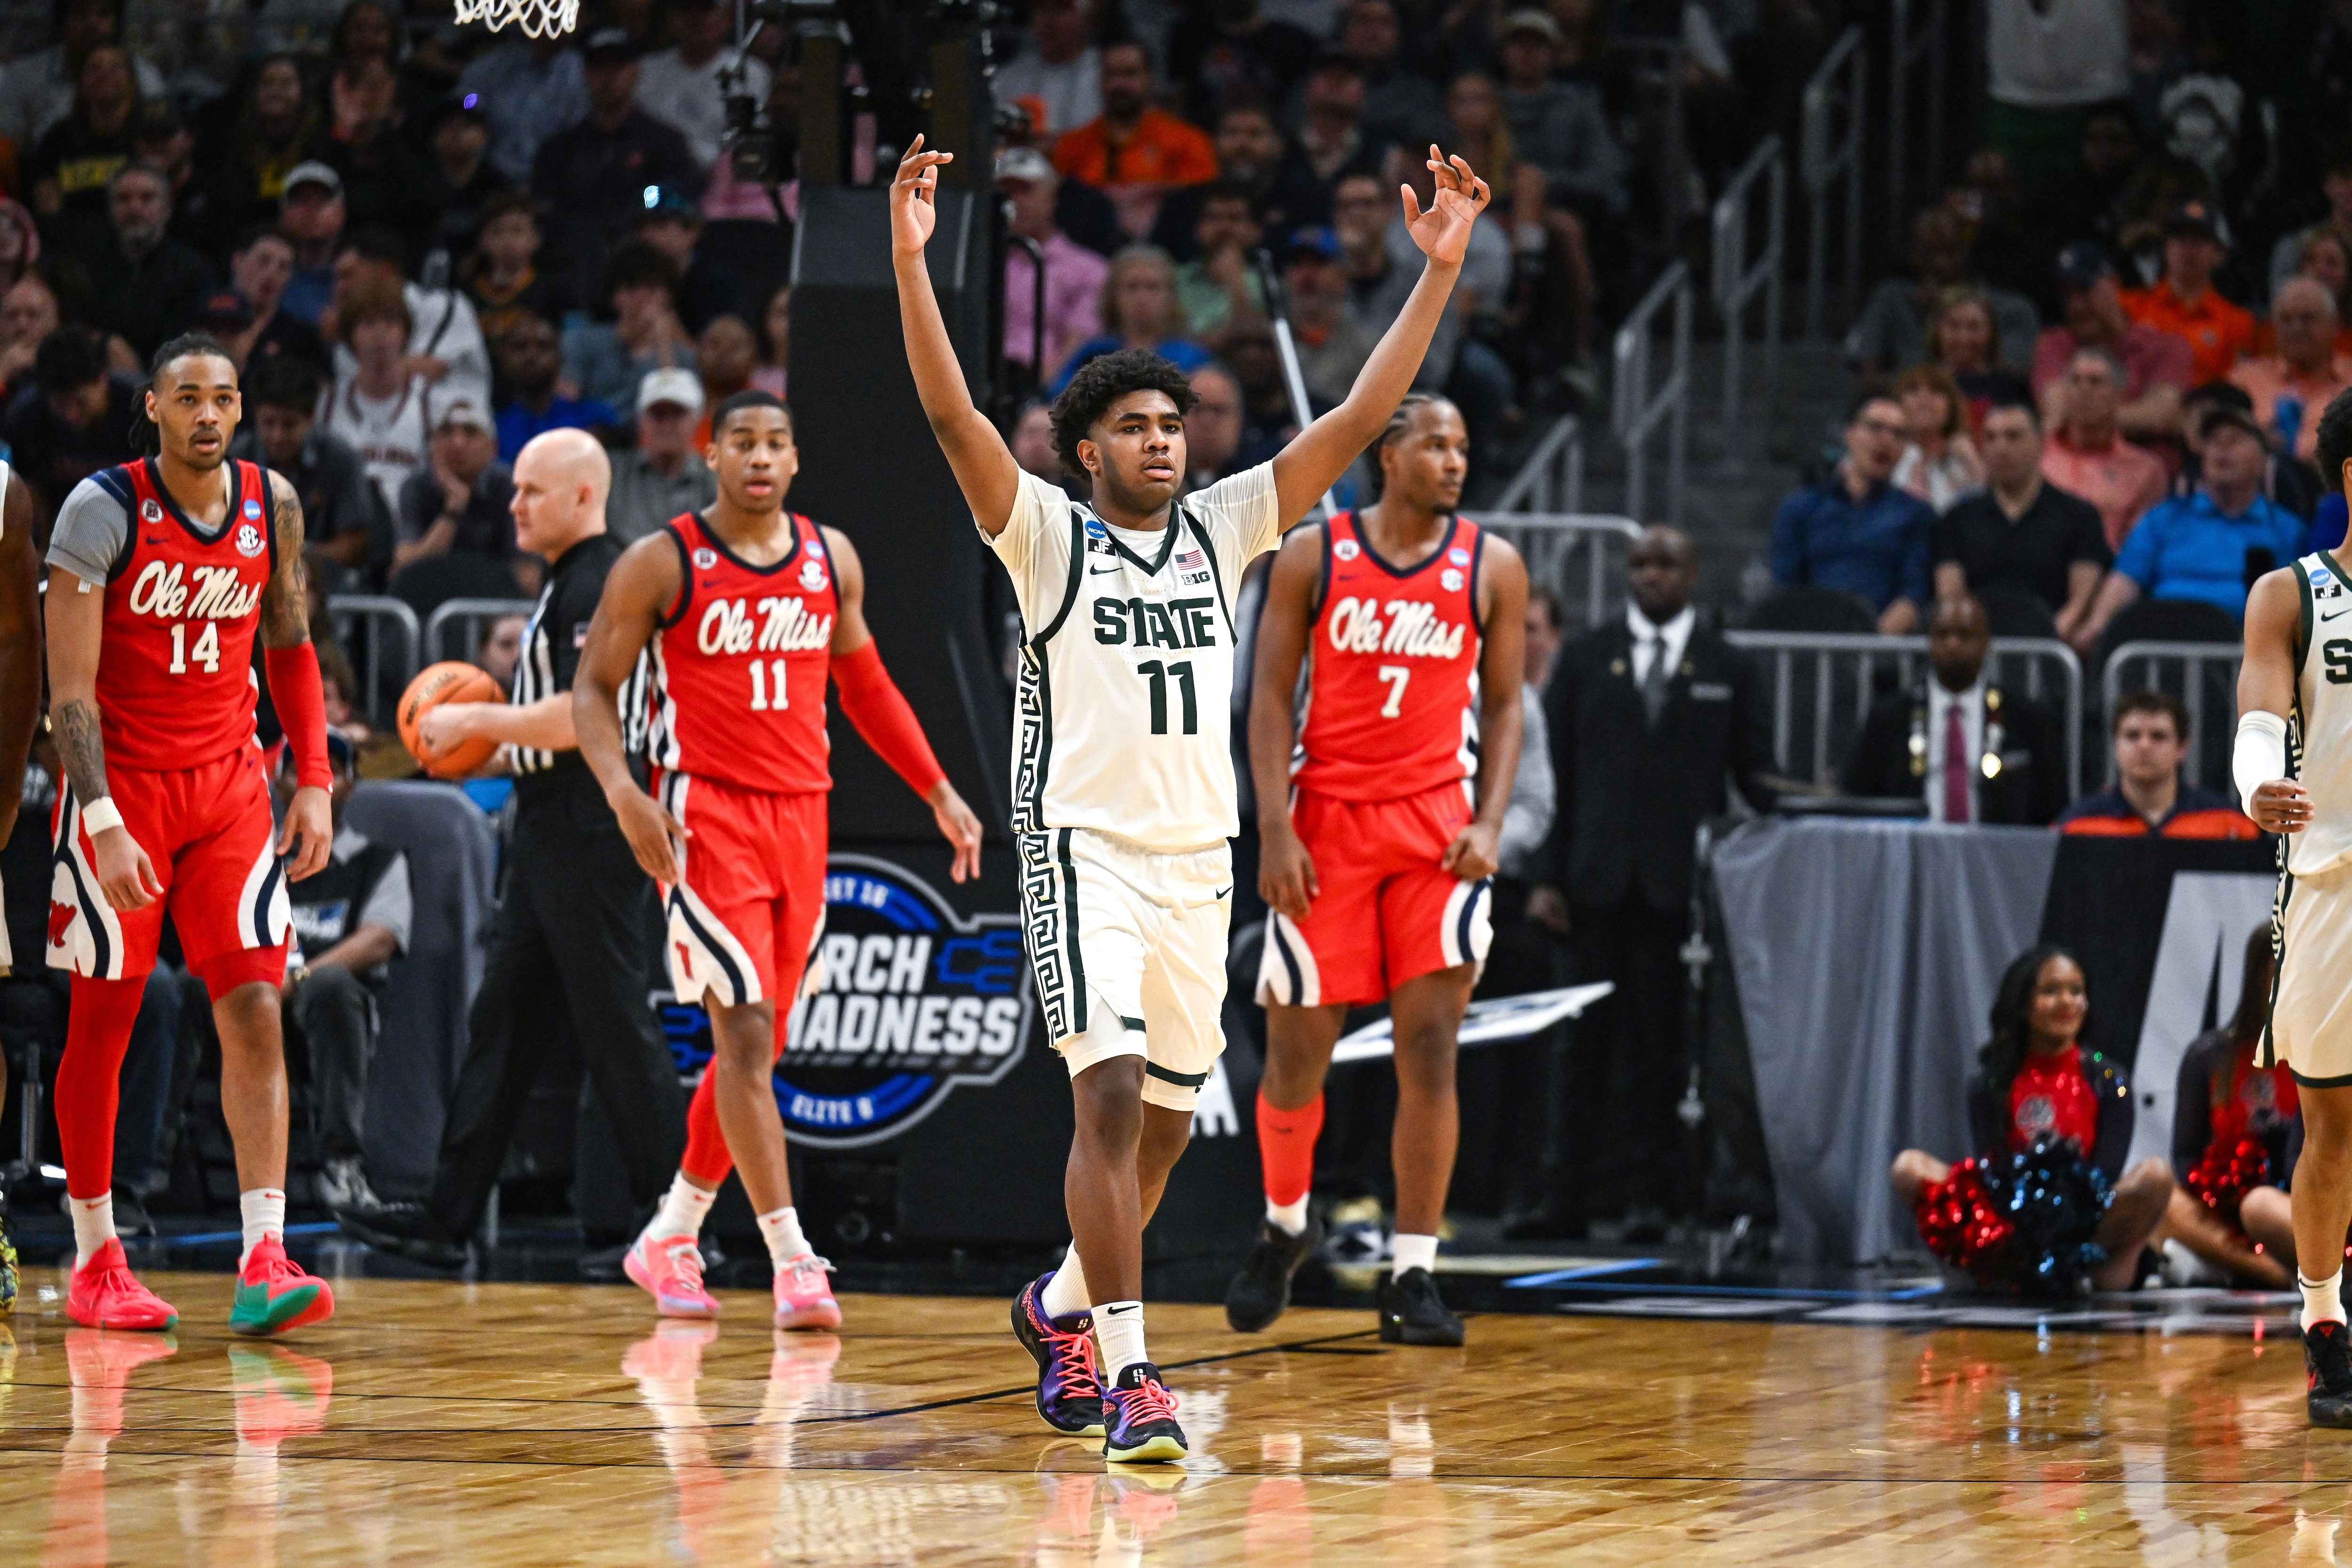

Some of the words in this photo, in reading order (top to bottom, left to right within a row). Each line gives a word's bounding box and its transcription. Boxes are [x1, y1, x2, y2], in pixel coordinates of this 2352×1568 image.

[239, 524, 259, 549] SEC
[1088, 526, 1106, 535] NCAA
[1094, 540, 1110, 554] JF
[130, 560, 187, 617] Ole
[187, 566, 262, 619] Miss
[169, 621, 220, 674] 14
[699, 597, 755, 655] Ole
[757, 596, 832, 652] Miss
[1093, 597, 1216, 650] STATE
[1329, 596, 1382, 653] Ole
[1382, 599, 1466, 660] Miss
[749, 659, 789, 710] 11
[2323, 638, 2352, 685] S
[1137, 660, 1198, 735] 11
[1378, 665, 1410, 718] 7
[821, 934, 932, 993] RCH
[791, 1094, 852, 1123] ELITE
